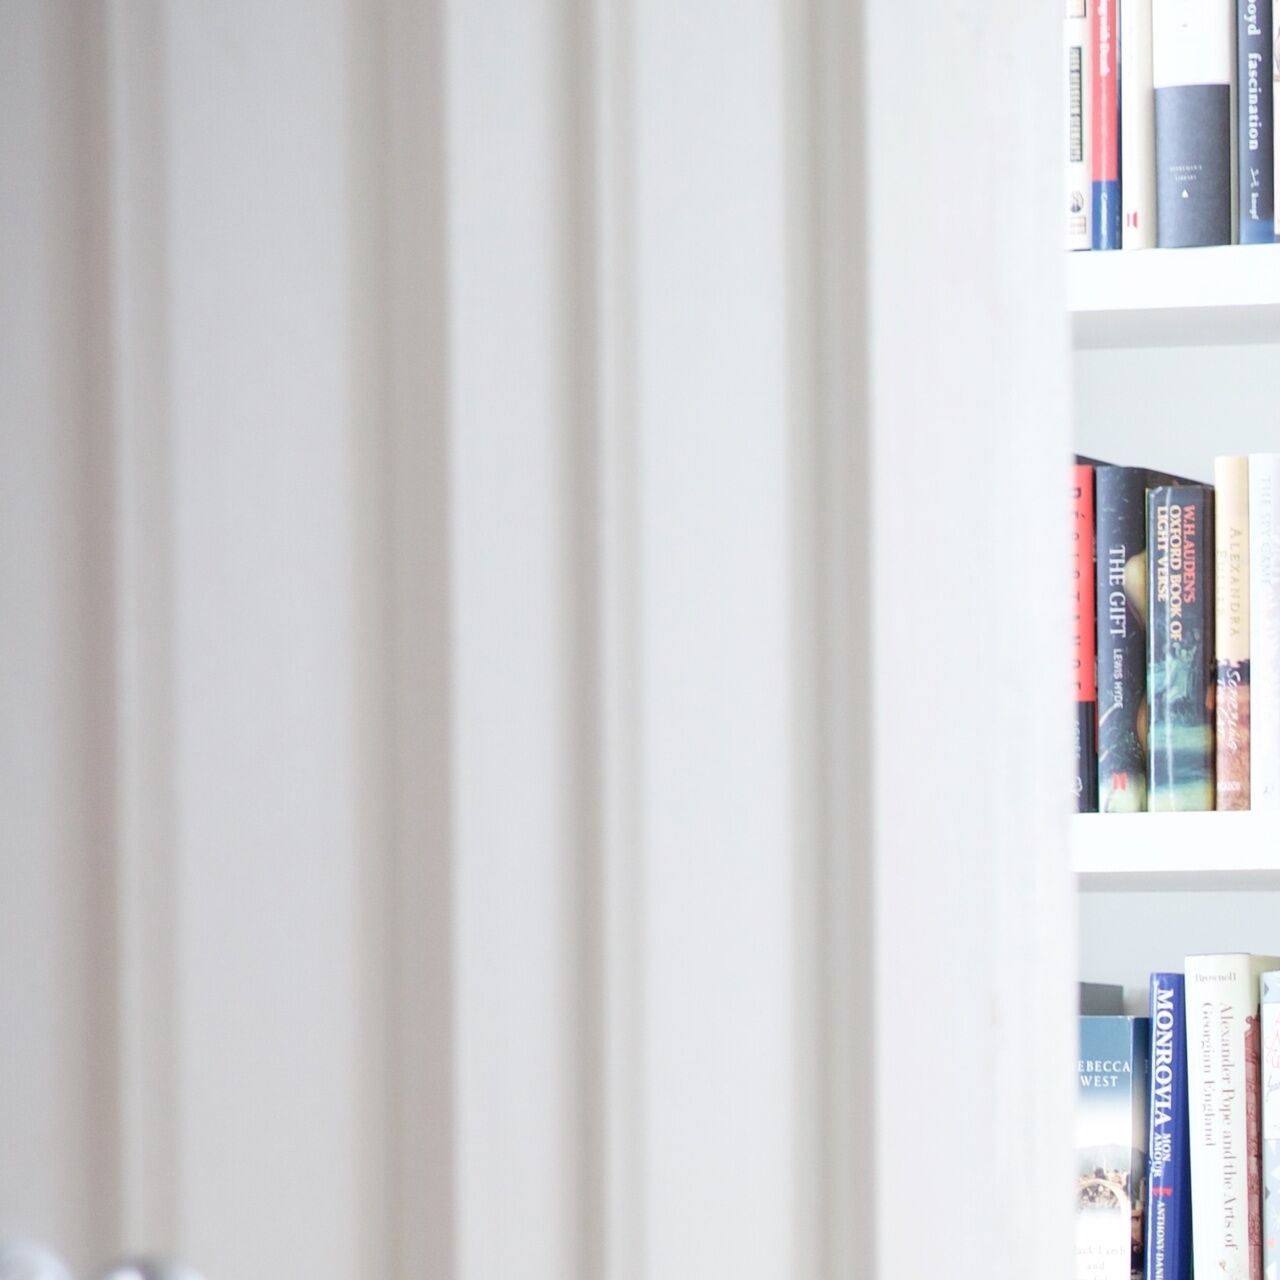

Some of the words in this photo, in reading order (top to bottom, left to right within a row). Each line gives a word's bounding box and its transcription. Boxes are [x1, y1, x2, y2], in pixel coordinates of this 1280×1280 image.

[1248, 53, 1260, 150] fascination
[1157, 506, 1169, 551] LIGHT
[1169, 505, 1182, 570] OXFORD
[1109, 545, 1125, 586] THE
[1157, 557, 1169, 601] VERSE
[1110, 593, 1125, 637] GIFT
[1170, 574, 1182, 618] BOOK
[1170, 621, 1182, 641] OF
[1113, 649, 1122, 678] LEWIS
[1114, 682, 1123, 708] HYDE
[1153, 989, 1174, 1127] MONROVIA
[1155, 1201, 1166, 1250] ANTHONY
